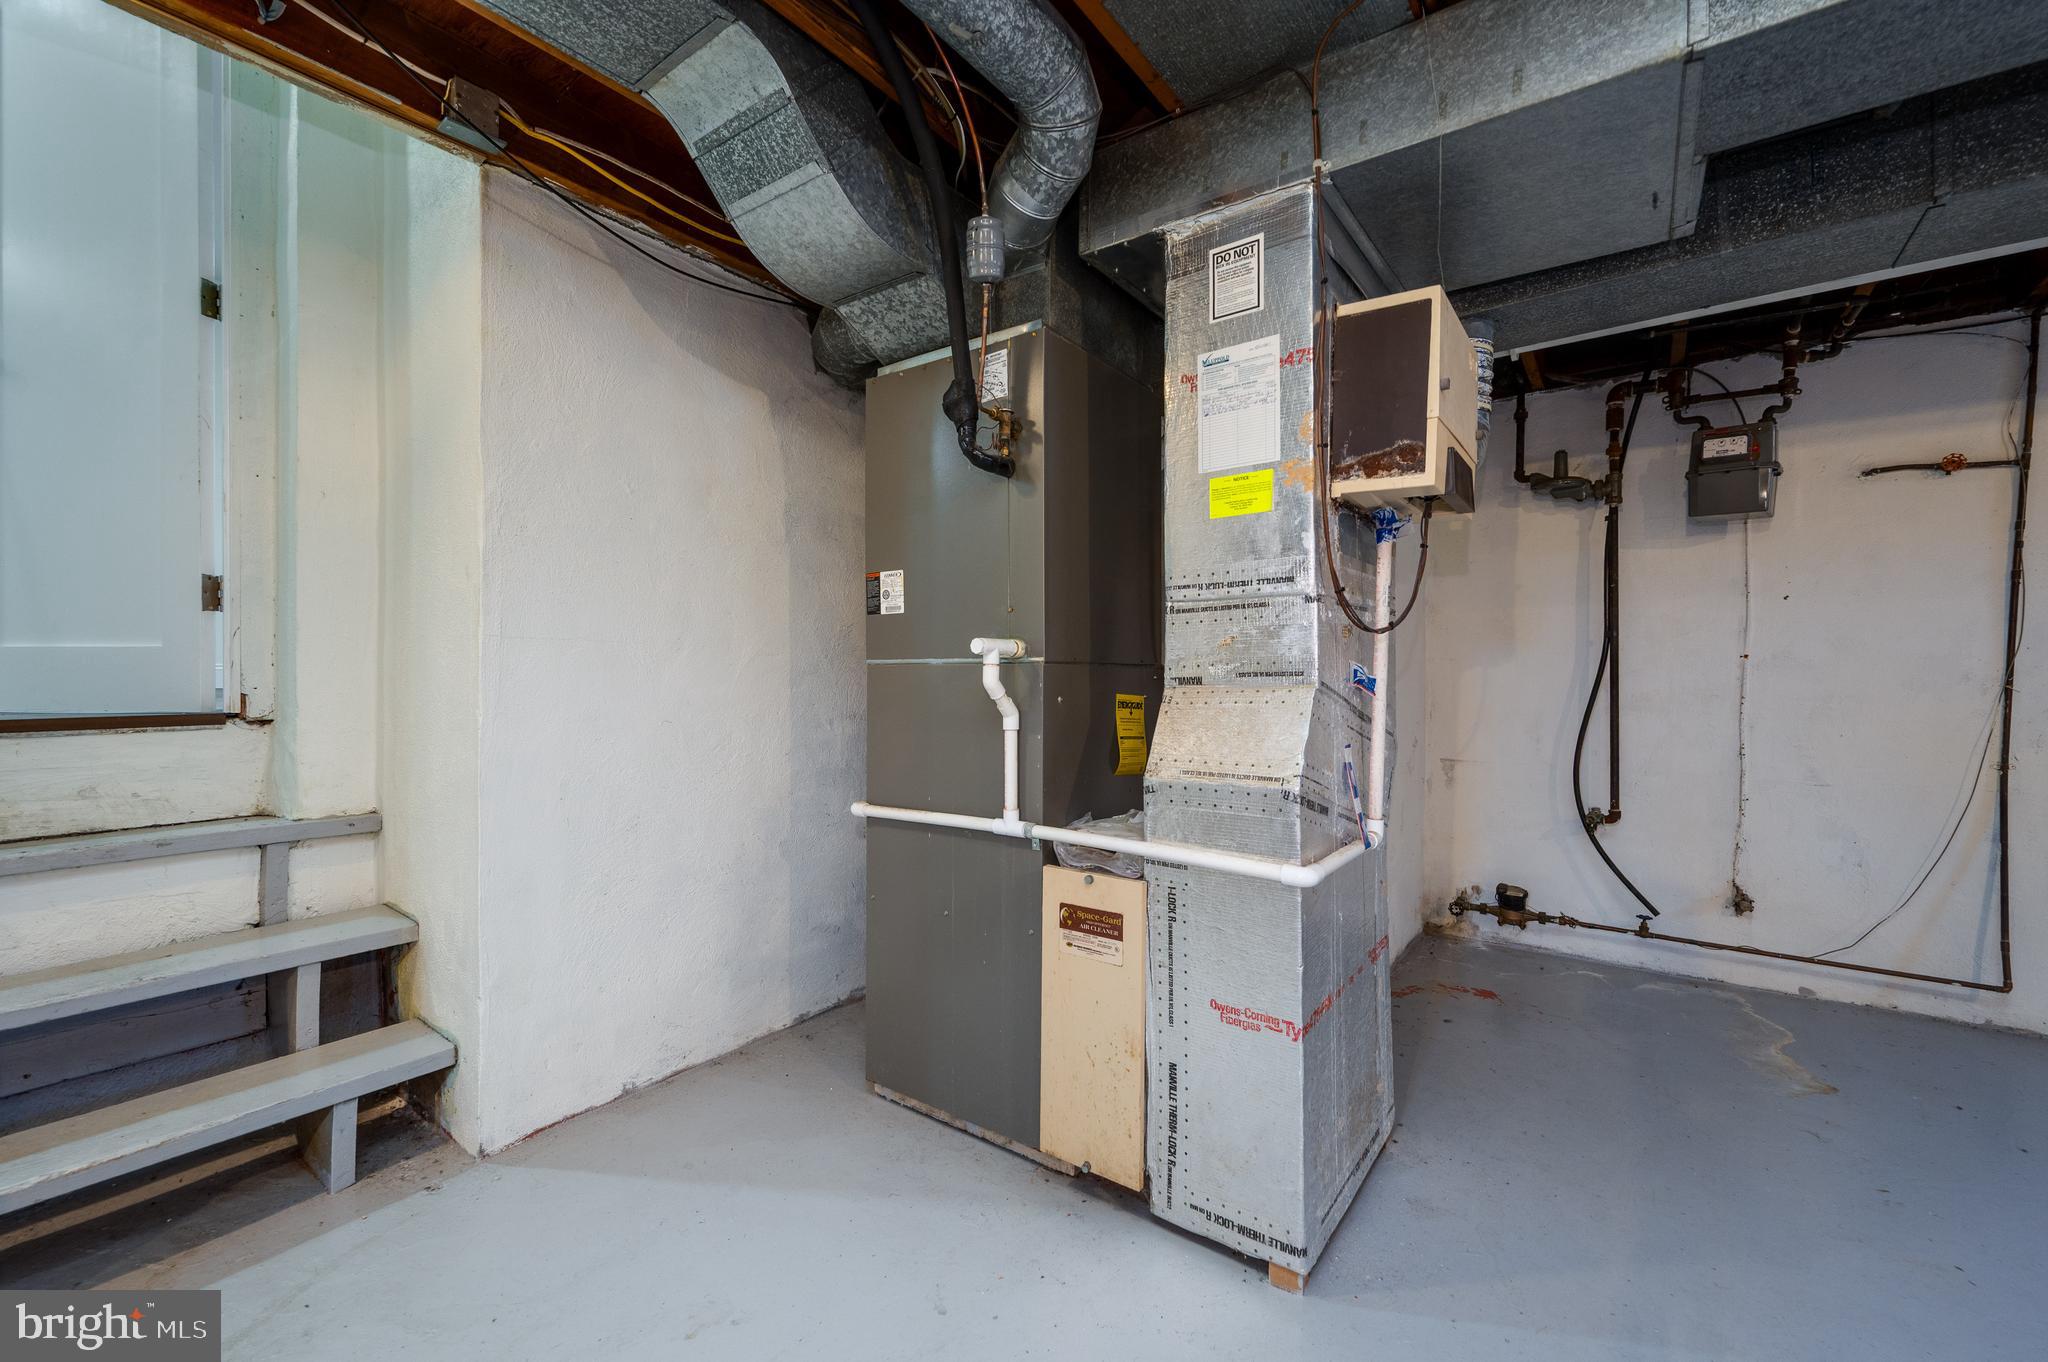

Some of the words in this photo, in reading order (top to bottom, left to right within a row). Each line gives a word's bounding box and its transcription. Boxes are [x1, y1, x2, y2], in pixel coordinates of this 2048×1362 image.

[1216, 253, 1231, 265] DO
[1233, 244, 1256, 260] NOT
[1076, 910, 1121, 926] Space-Gard
[1168, 1061, 1178, 1103] MANVILLE
[1167, 1104, 1178, 1159] THERM-LOCK
[1213, 1213, 1266, 1246] THERM-LOCK
